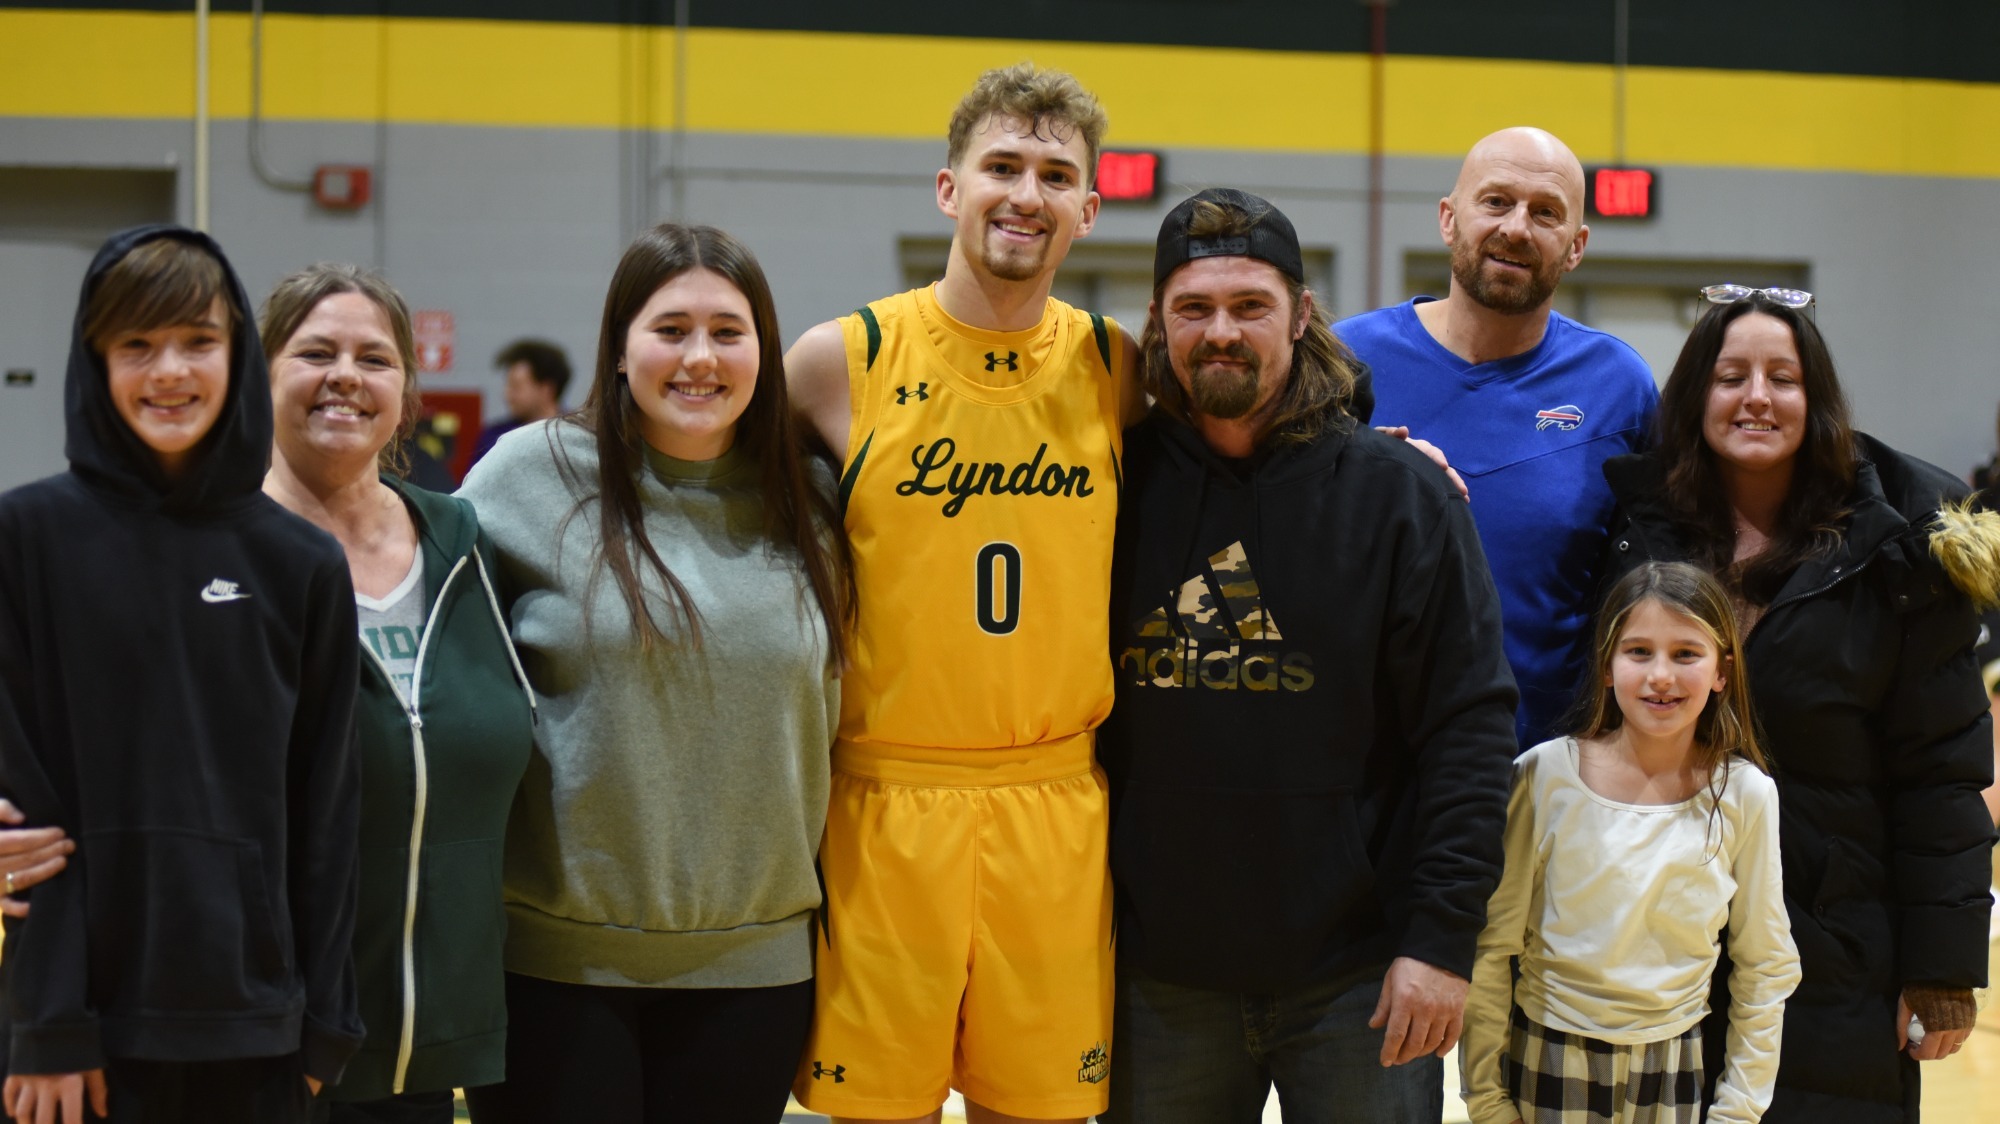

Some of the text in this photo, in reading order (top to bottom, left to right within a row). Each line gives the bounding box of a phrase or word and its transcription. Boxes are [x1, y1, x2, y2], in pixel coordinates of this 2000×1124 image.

[895, 437, 1094, 518] Lyndon
[210, 578, 239, 595] NIKE
[975, 541, 1022, 636] 0
[1119, 637, 1315, 692] adidas
